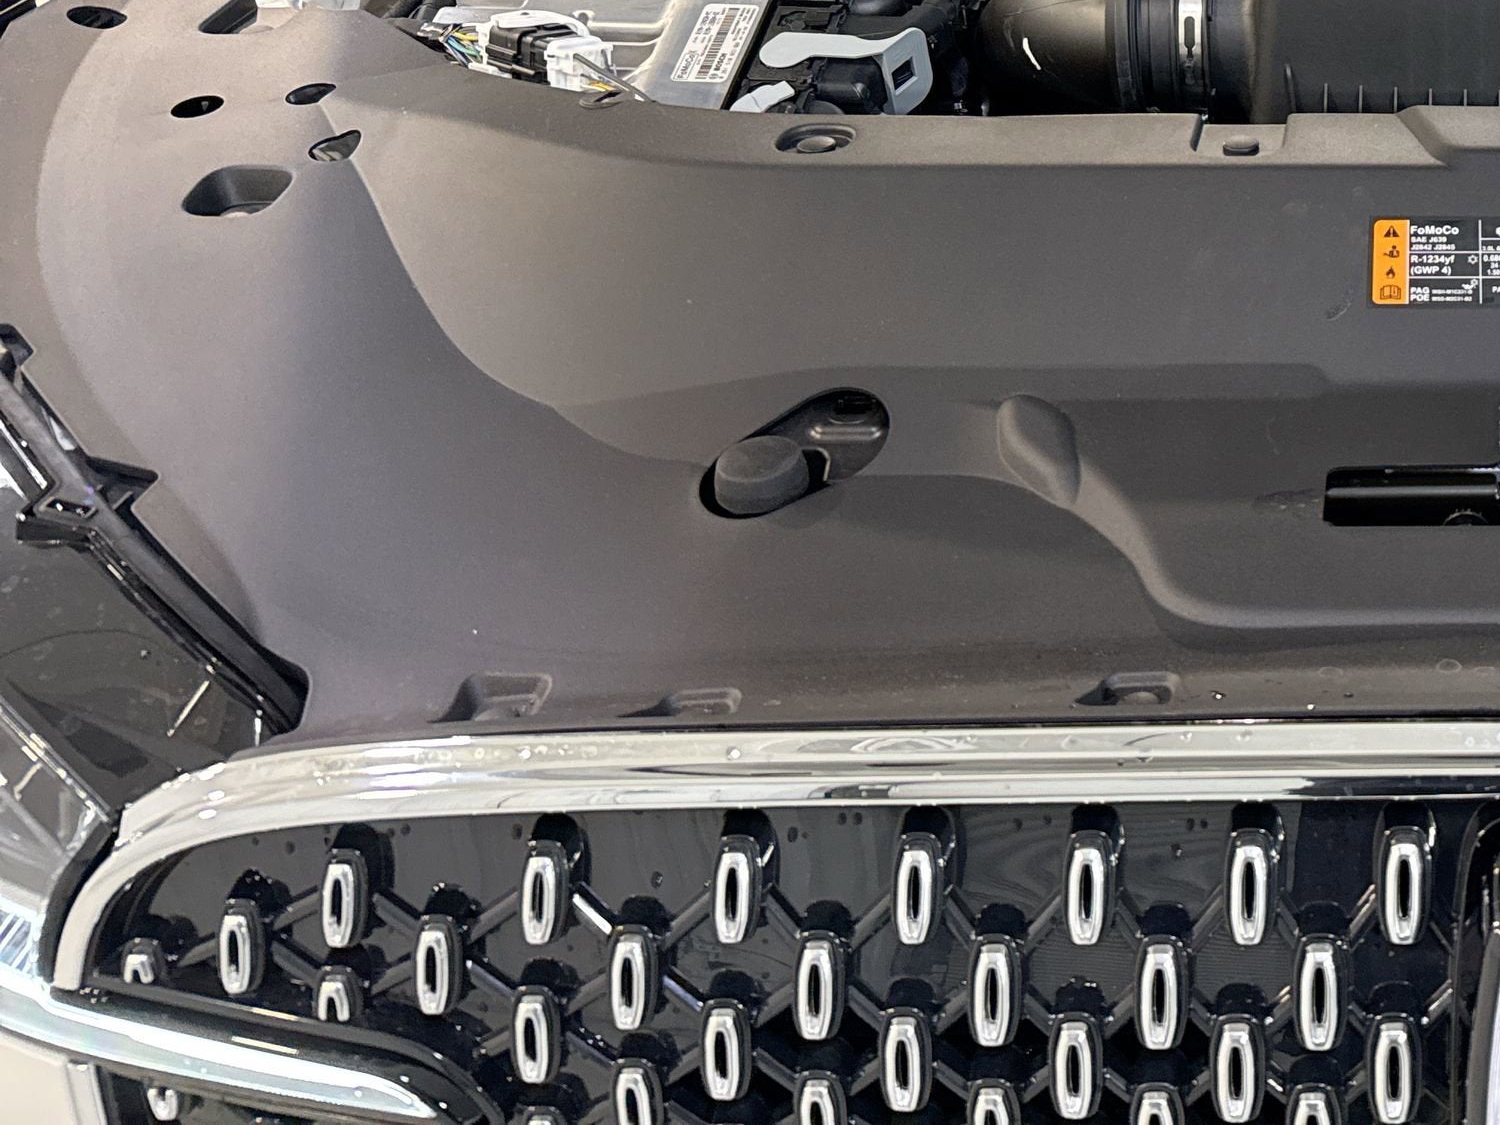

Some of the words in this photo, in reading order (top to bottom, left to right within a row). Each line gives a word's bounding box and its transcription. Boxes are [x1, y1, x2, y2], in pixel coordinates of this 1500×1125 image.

[714, 53, 727, 71] BOSCH
[1410, 225, 1459, 234] FoMoCo
[1410, 255, 1455, 264] R-1234yf
[1410, 266, 1439, 275] (GWP
[1441, 266, 1452, 275] 4)
